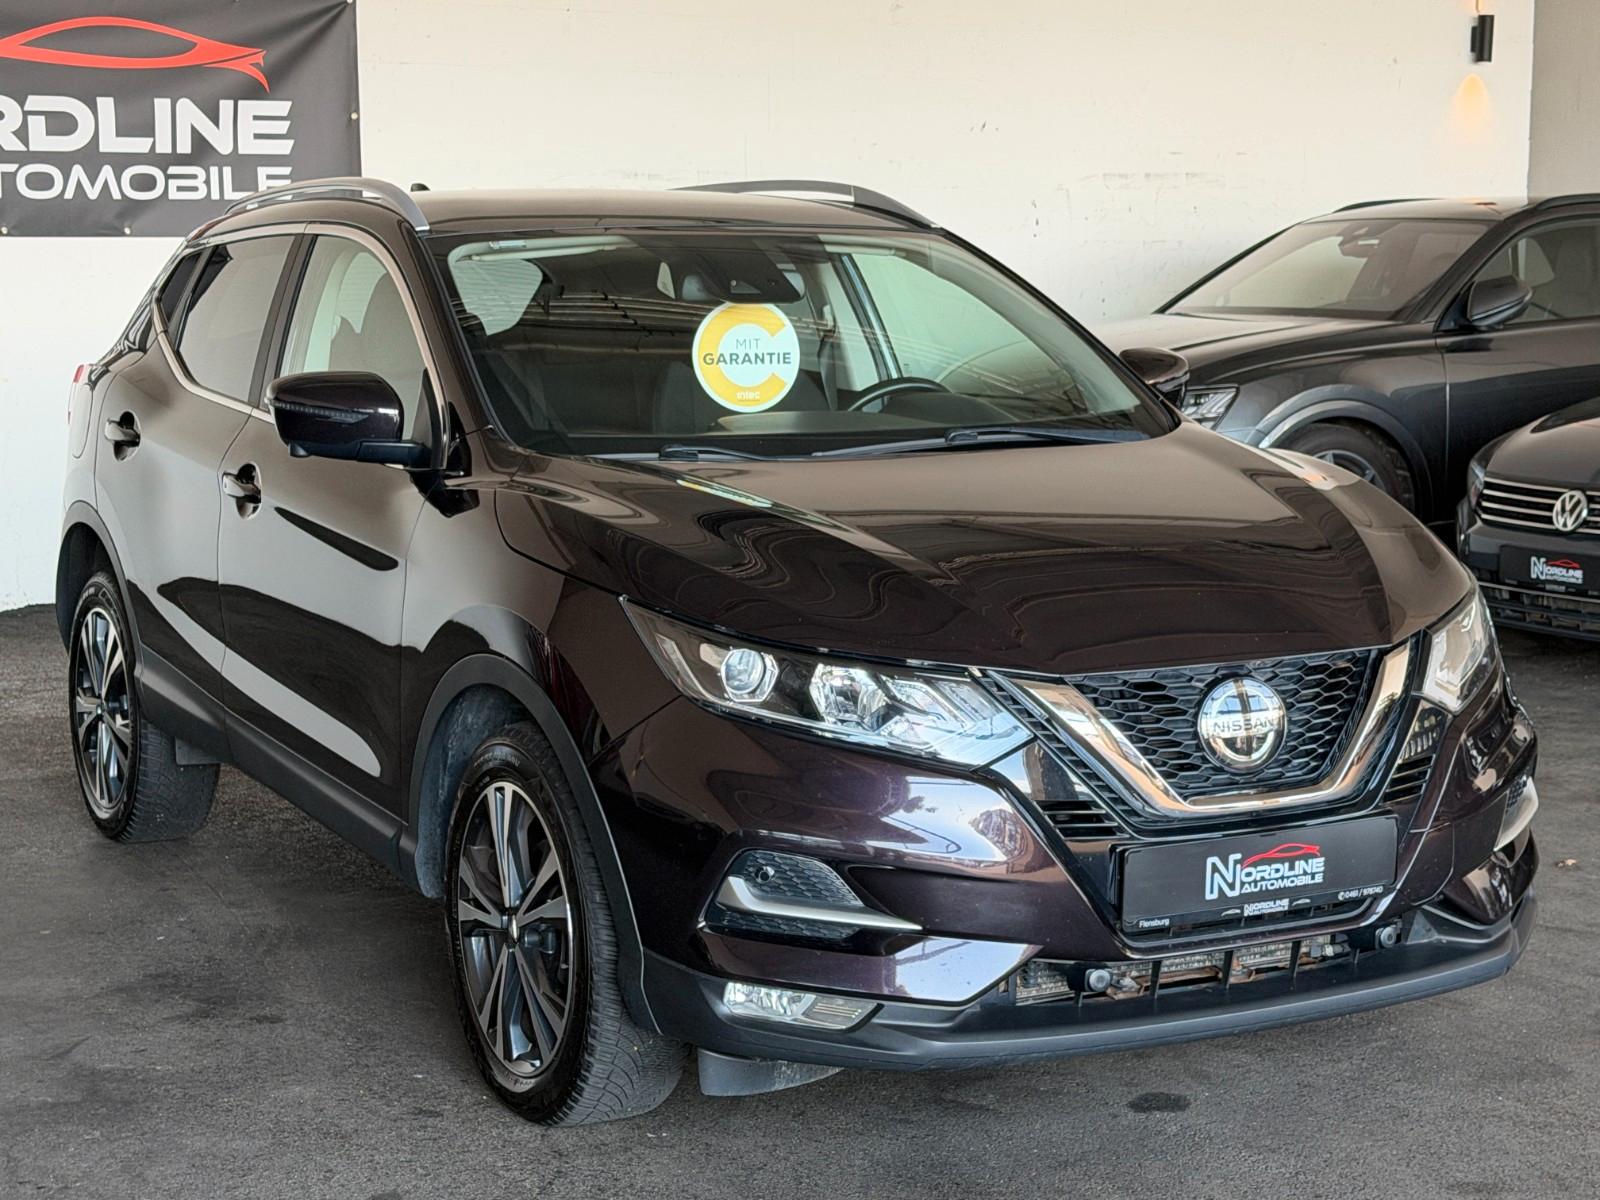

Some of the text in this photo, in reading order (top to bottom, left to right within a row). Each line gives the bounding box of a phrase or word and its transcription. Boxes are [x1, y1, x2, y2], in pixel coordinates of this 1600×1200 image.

[735, 338, 761, 351] MIT
[702, 351, 792, 366] GARANTIE
[1213, 718, 1274, 734] NISSAN
[1205, 853, 1326, 900] NORDLINE
[1241, 872, 1324, 894] AUTOMOBILE
[1138, 918, 1170, 929] Flensburg
